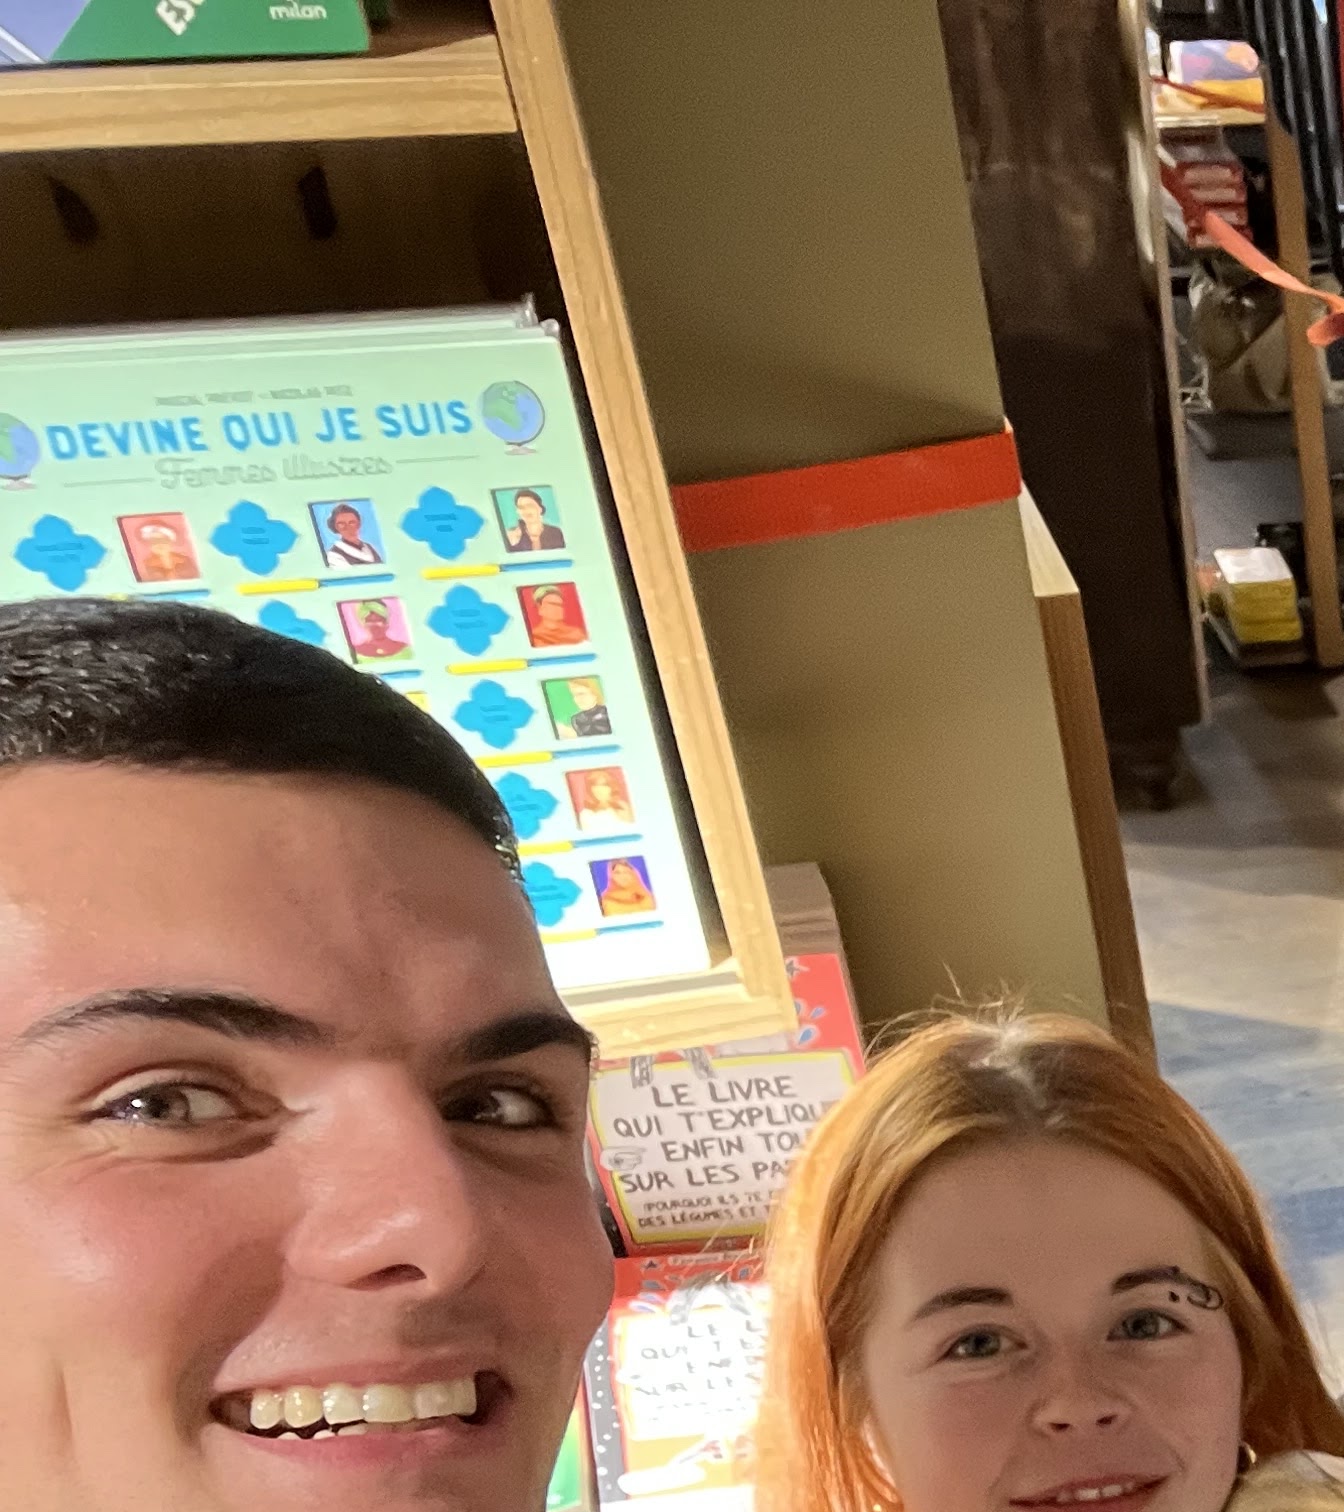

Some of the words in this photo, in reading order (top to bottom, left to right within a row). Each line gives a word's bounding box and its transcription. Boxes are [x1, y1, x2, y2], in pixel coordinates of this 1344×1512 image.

[269, 1, 327, 20] milan
[46, 416, 208, 460] DEVINE
[222, 411, 299, 452] QUI
[315, 407, 364, 442] JE
[375, 400, 473, 438] SUIS
[652, 1083, 696, 1108] LE
[708, 1076, 797, 1103] LIVRE
[613, 1115, 662, 1138] QUI
[678, 1101, 824, 1132] T'EXPLIQ
[661, 1136, 744, 1162] ENFIN
[618, 1171, 674, 1193] SUR
[686, 1163, 740, 1187] LES
[638, 1216, 665, 1228] DES
